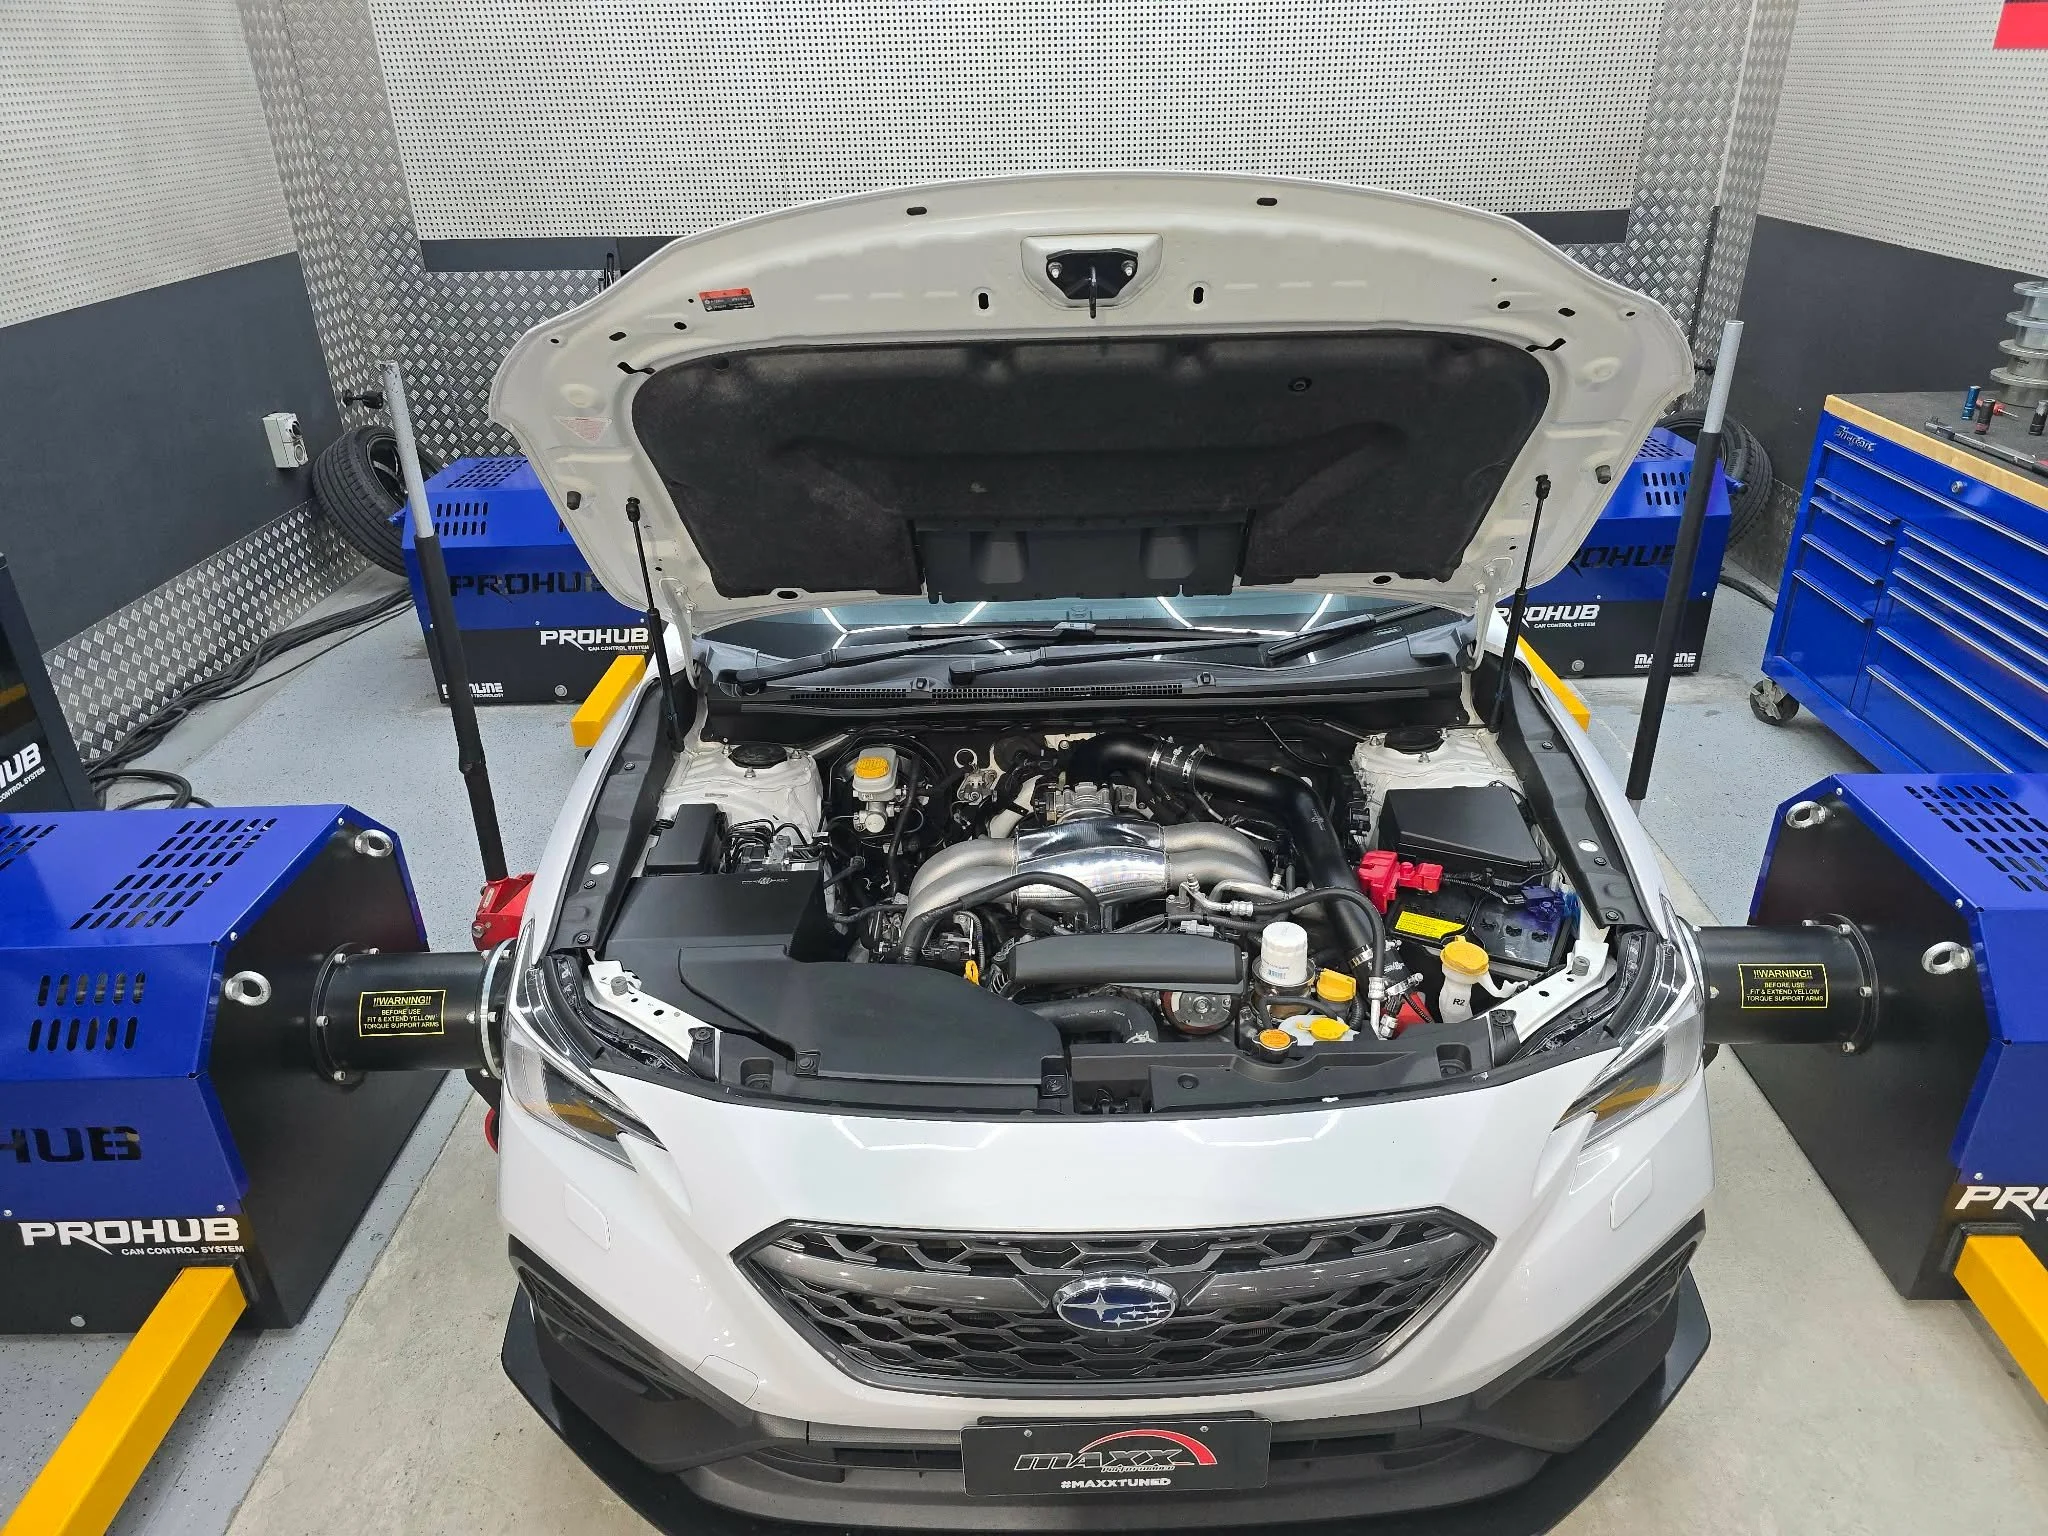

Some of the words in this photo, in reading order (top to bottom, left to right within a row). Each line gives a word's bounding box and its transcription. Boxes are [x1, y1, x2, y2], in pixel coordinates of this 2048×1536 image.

[540, 628, 649, 651] PROHUB
[24, 766, 46, 784] SYSTEM
[1754, 969, 1812, 979] !!WARNING!!
[373, 996, 431, 1006] !!WARNING!!
[1453, 998, 1465, 1006] R2
[18, 1217, 240, 1255] PROHUB
[121, 1248, 145, 1256] CAN
[146, 1246, 199, 1255] CONTROL
[200, 1245, 245, 1254] SYSTEM
[1060, 1477, 1171, 1489] #MAXXTUNED
